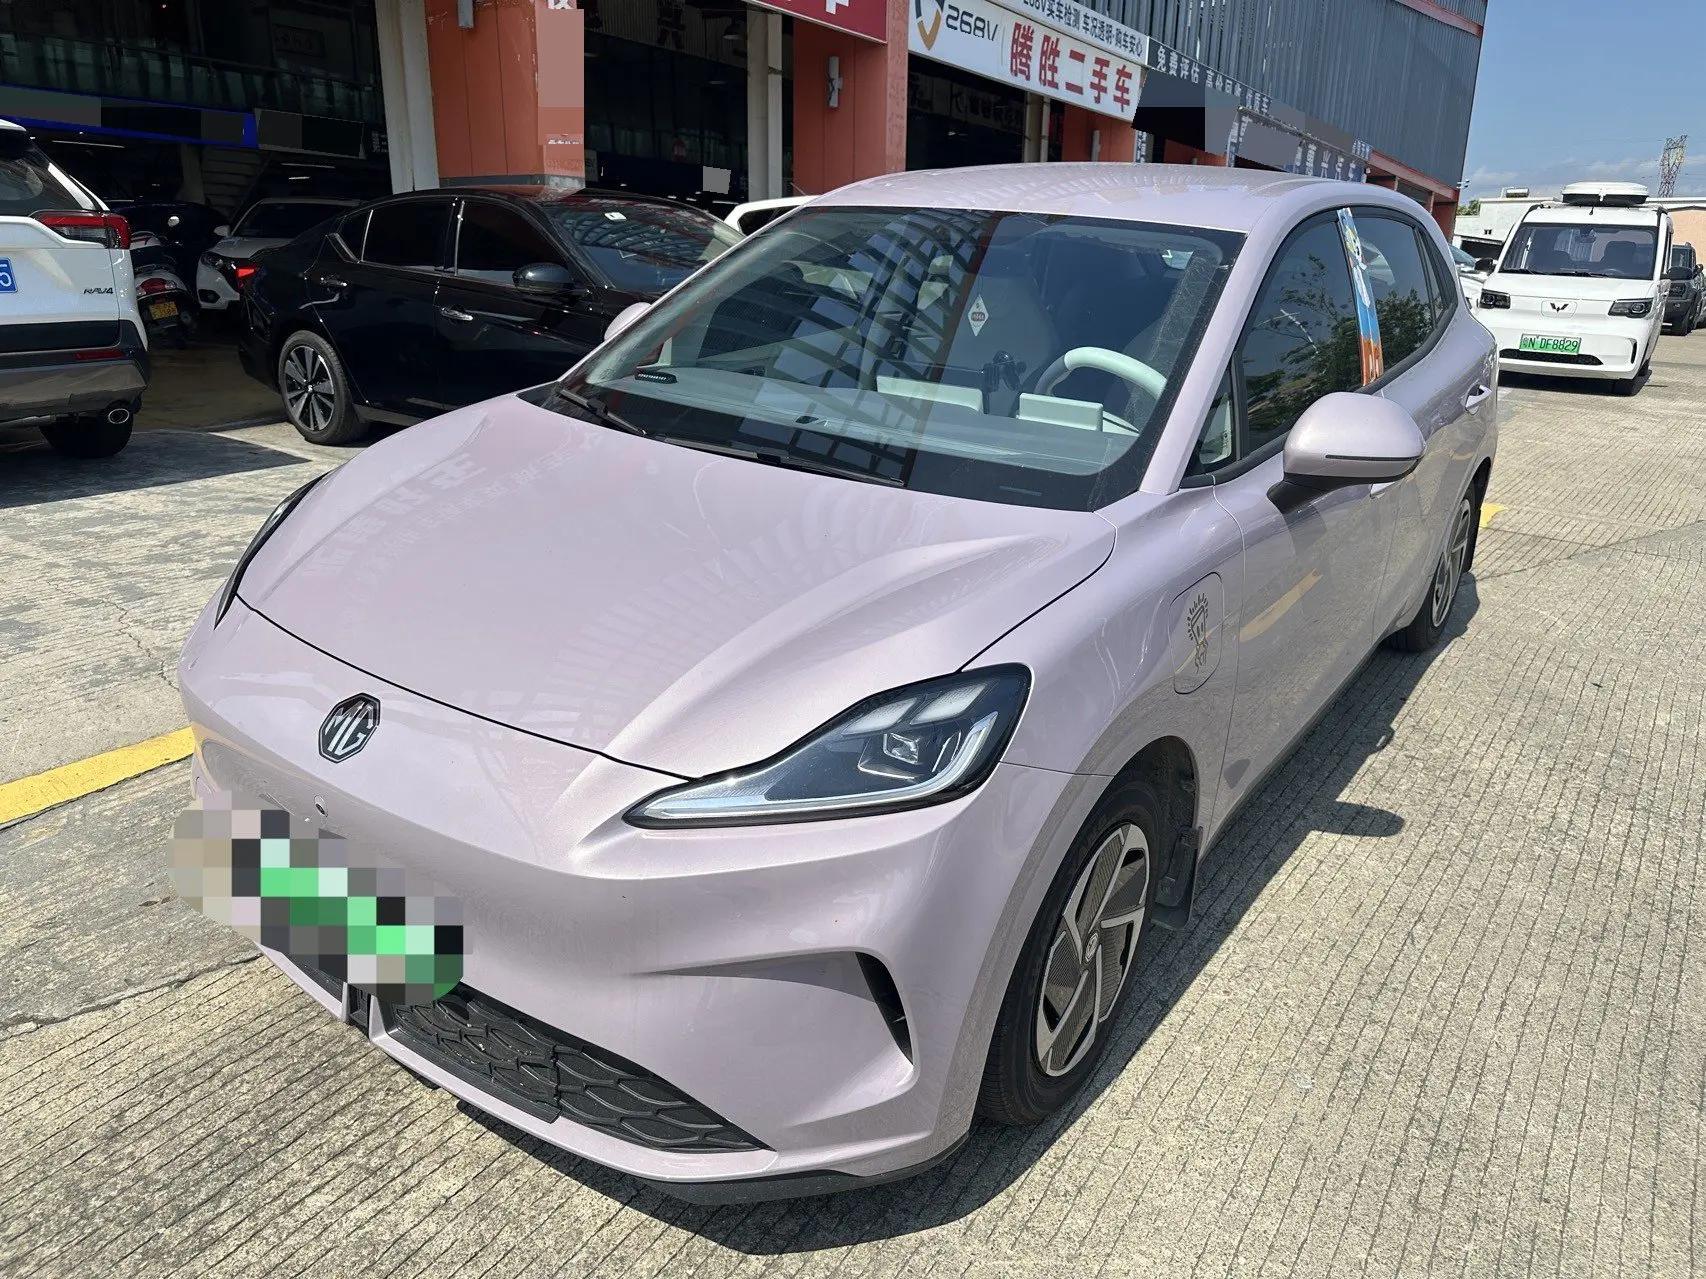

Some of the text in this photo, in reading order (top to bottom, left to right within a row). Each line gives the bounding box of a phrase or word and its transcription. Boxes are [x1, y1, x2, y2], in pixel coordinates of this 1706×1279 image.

[945, 4, 999, 42] 268V
[1023, 0, 1080, 31] 8V买车检测
[1009, 21, 1133, 113] 腾胜二手车
[1157, 45, 1200, 84] 免费评估
[83, 287, 114, 295] RAV4
[324, 700, 375, 757] MG
